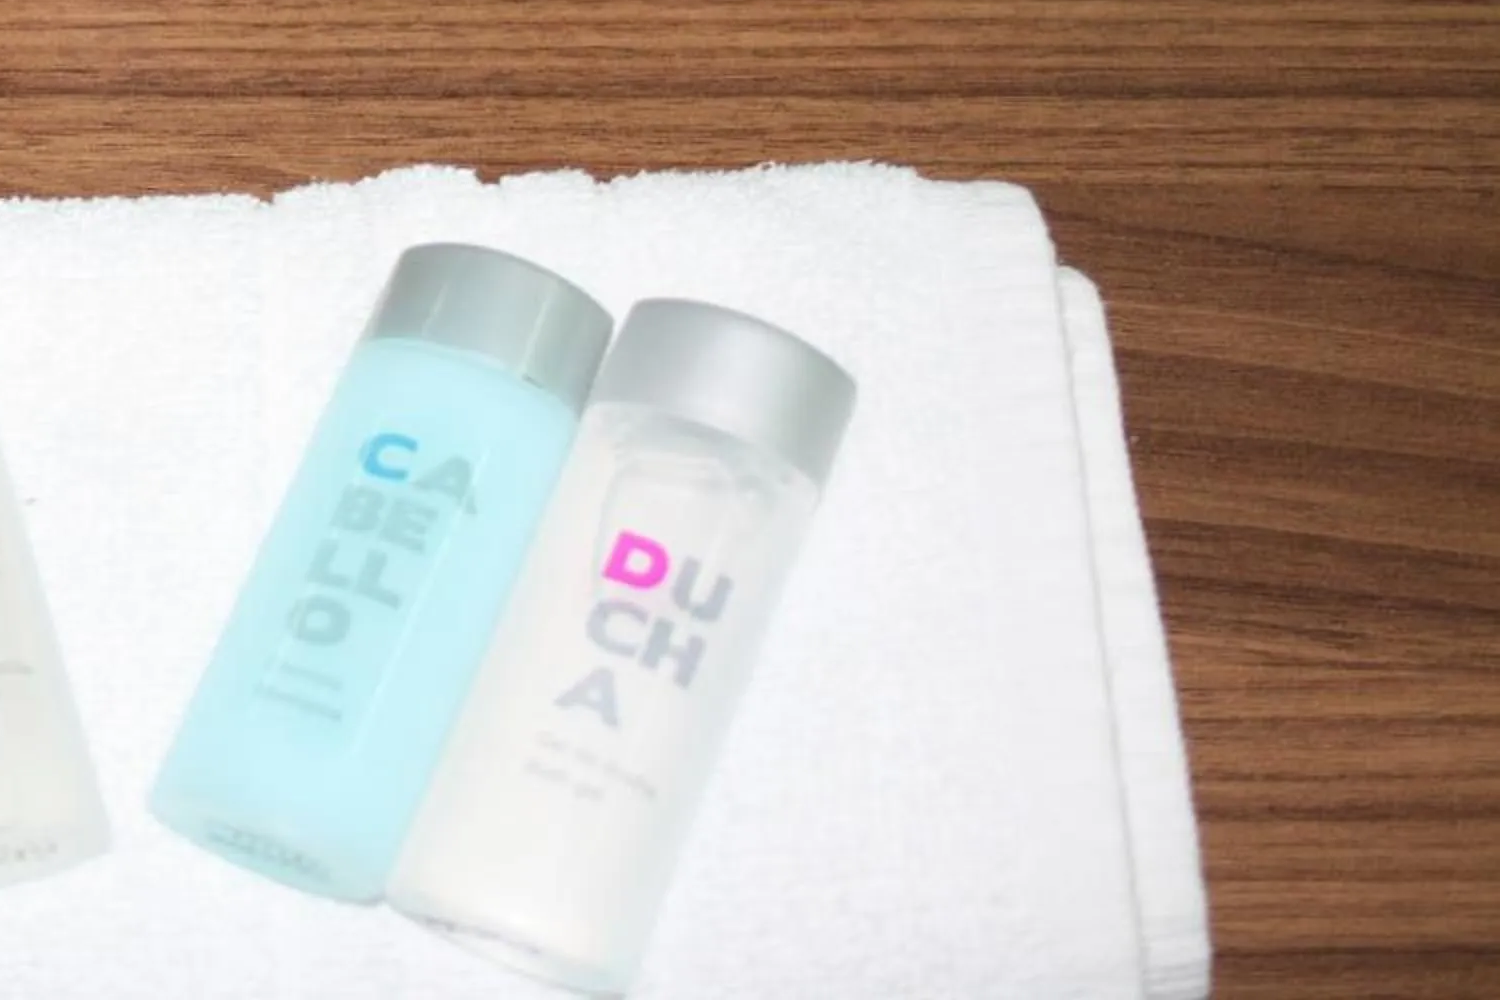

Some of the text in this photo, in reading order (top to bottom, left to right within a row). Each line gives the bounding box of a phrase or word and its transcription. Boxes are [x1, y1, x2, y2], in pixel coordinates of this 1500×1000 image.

[601, 529, 733, 624] DU
[586, 600, 707, 689] CH
[554, 669, 621, 729] A
